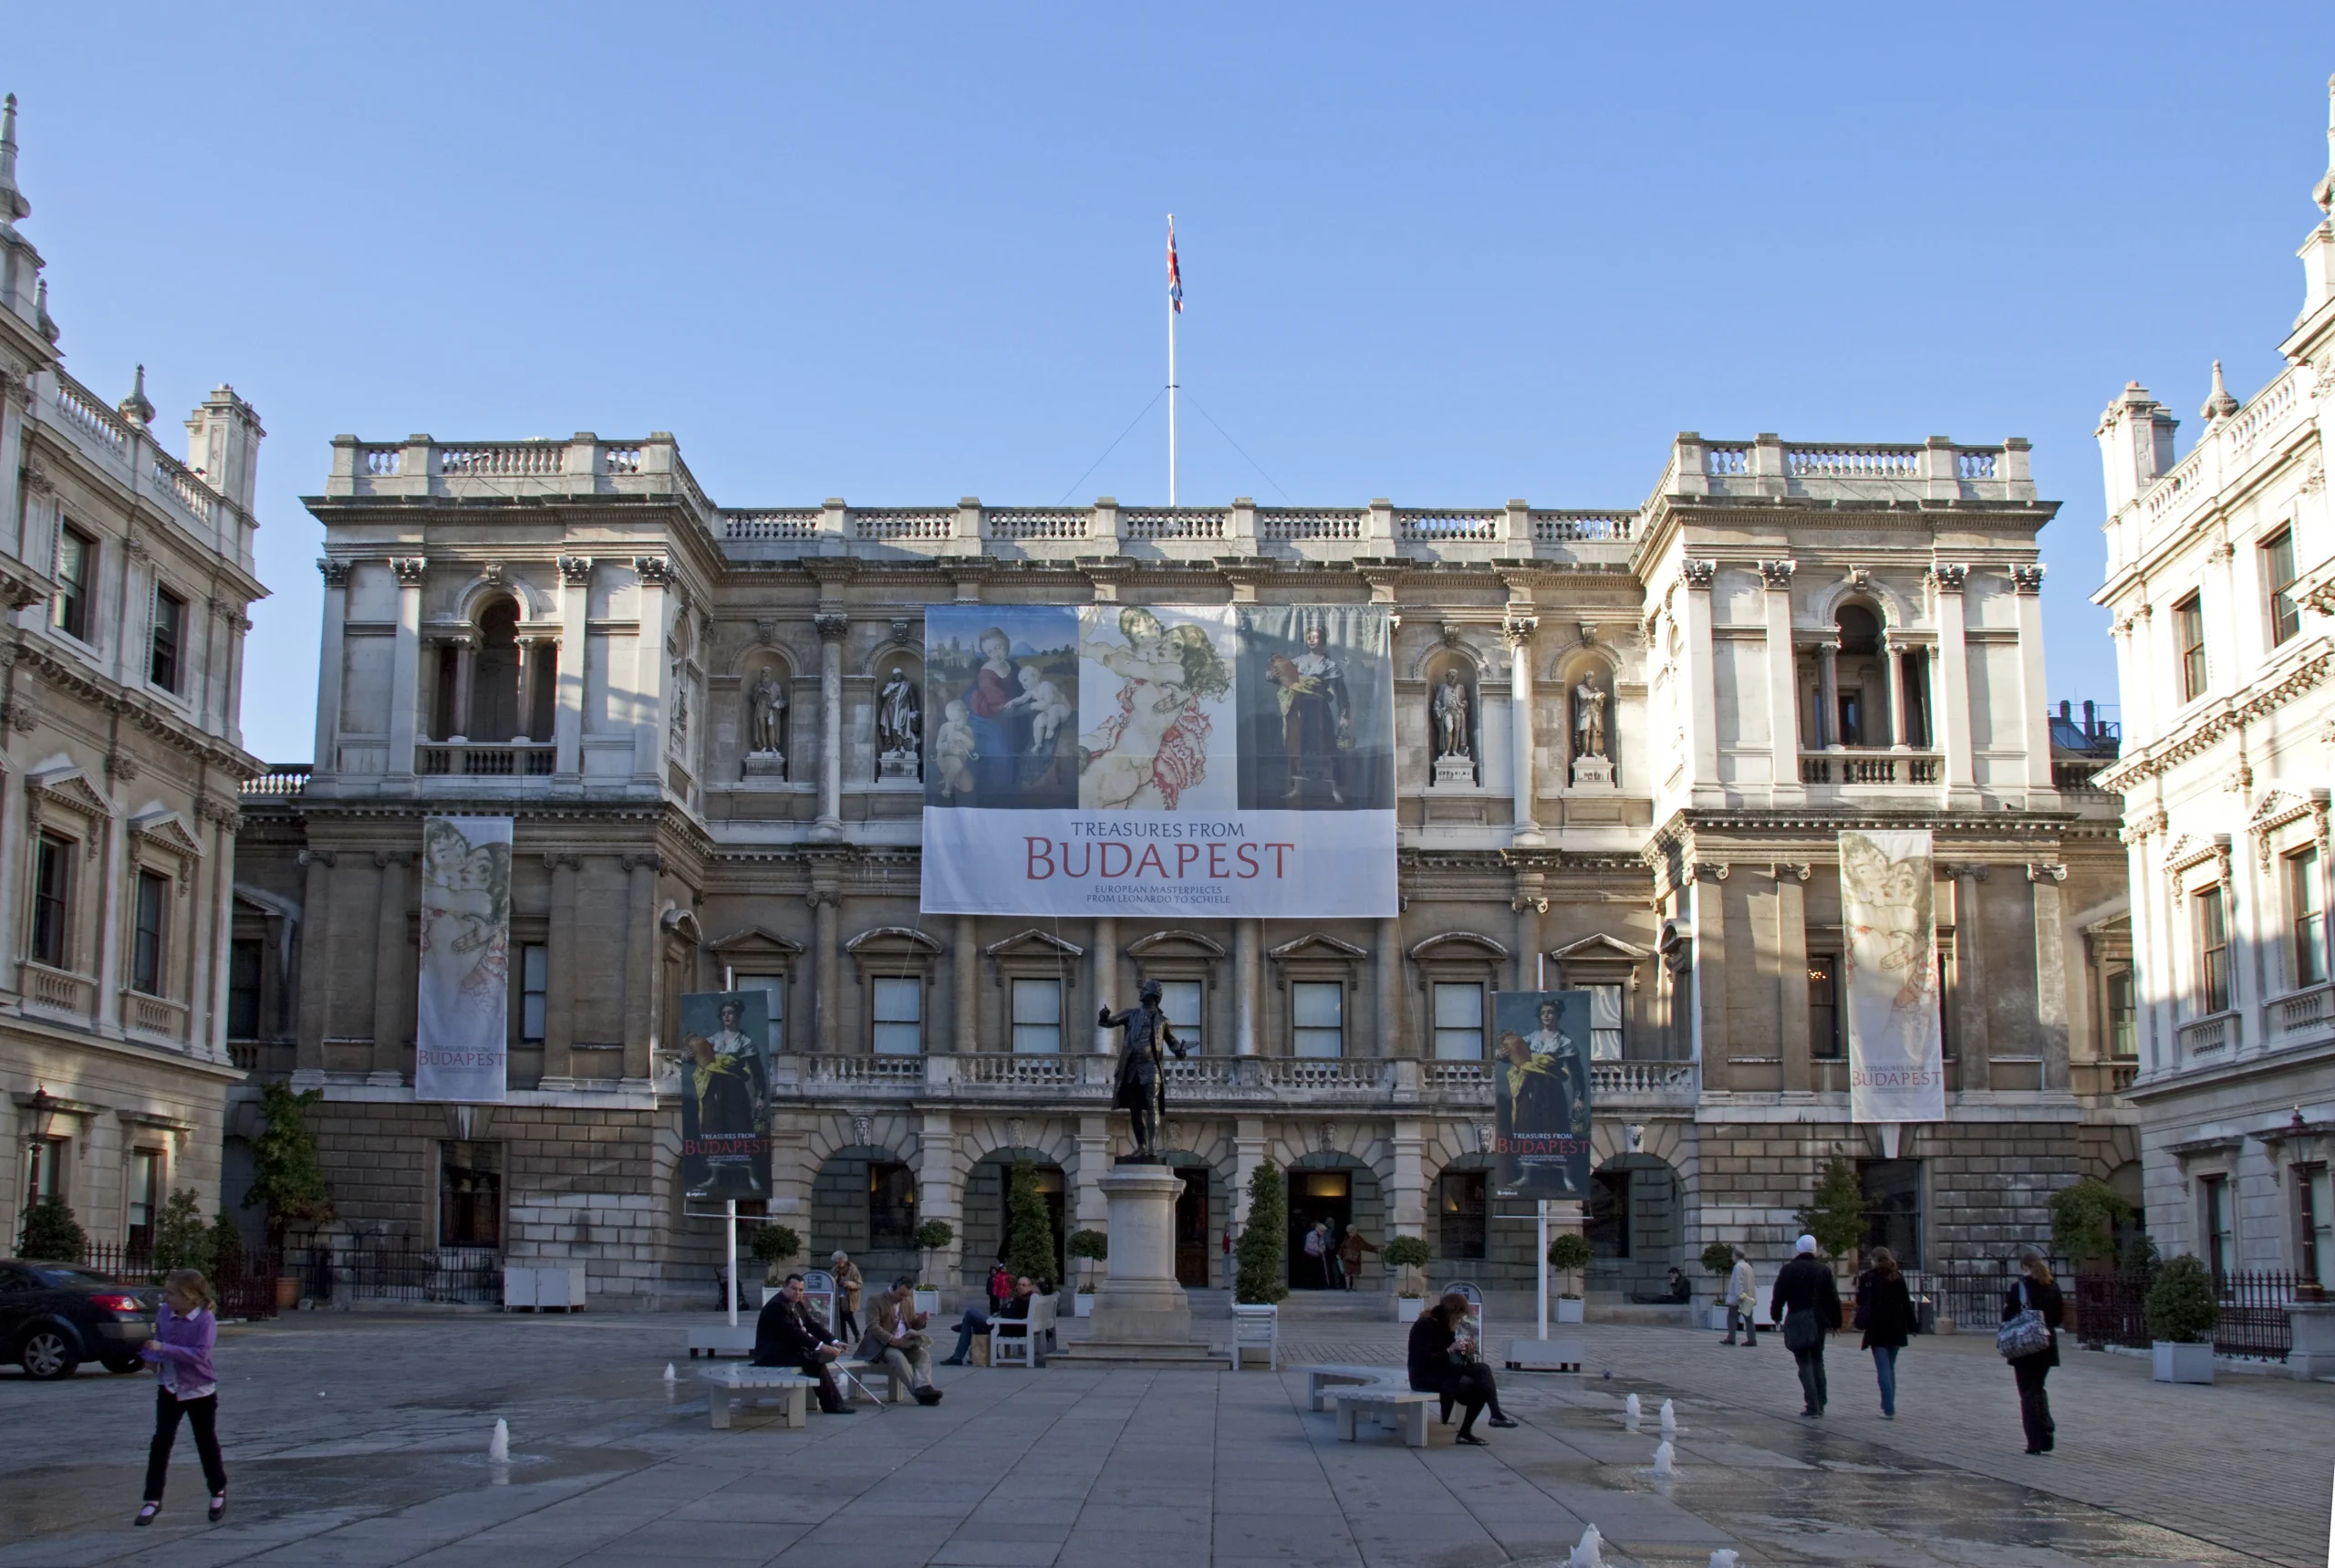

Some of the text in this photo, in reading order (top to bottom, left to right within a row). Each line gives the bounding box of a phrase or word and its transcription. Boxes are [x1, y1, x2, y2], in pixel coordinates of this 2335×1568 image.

[1071, 822, 1246, 837] TREASURES FROM
[1022, 836, 1294, 879] BUDAPEST
[1095, 885, 1222, 895] EUROPEAN MASTERPIECES
[1086, 895, 1230, 904] FROM LEONARDO TO SCHIELE
[419, 1050, 506, 1065] BUDAPEST
[1852, 1071, 1942, 1086] BUDAPEST
[685, 1139, 770, 1156] BUDAPEST
[1497, 1137, 1590, 1154] BUDAPEST
